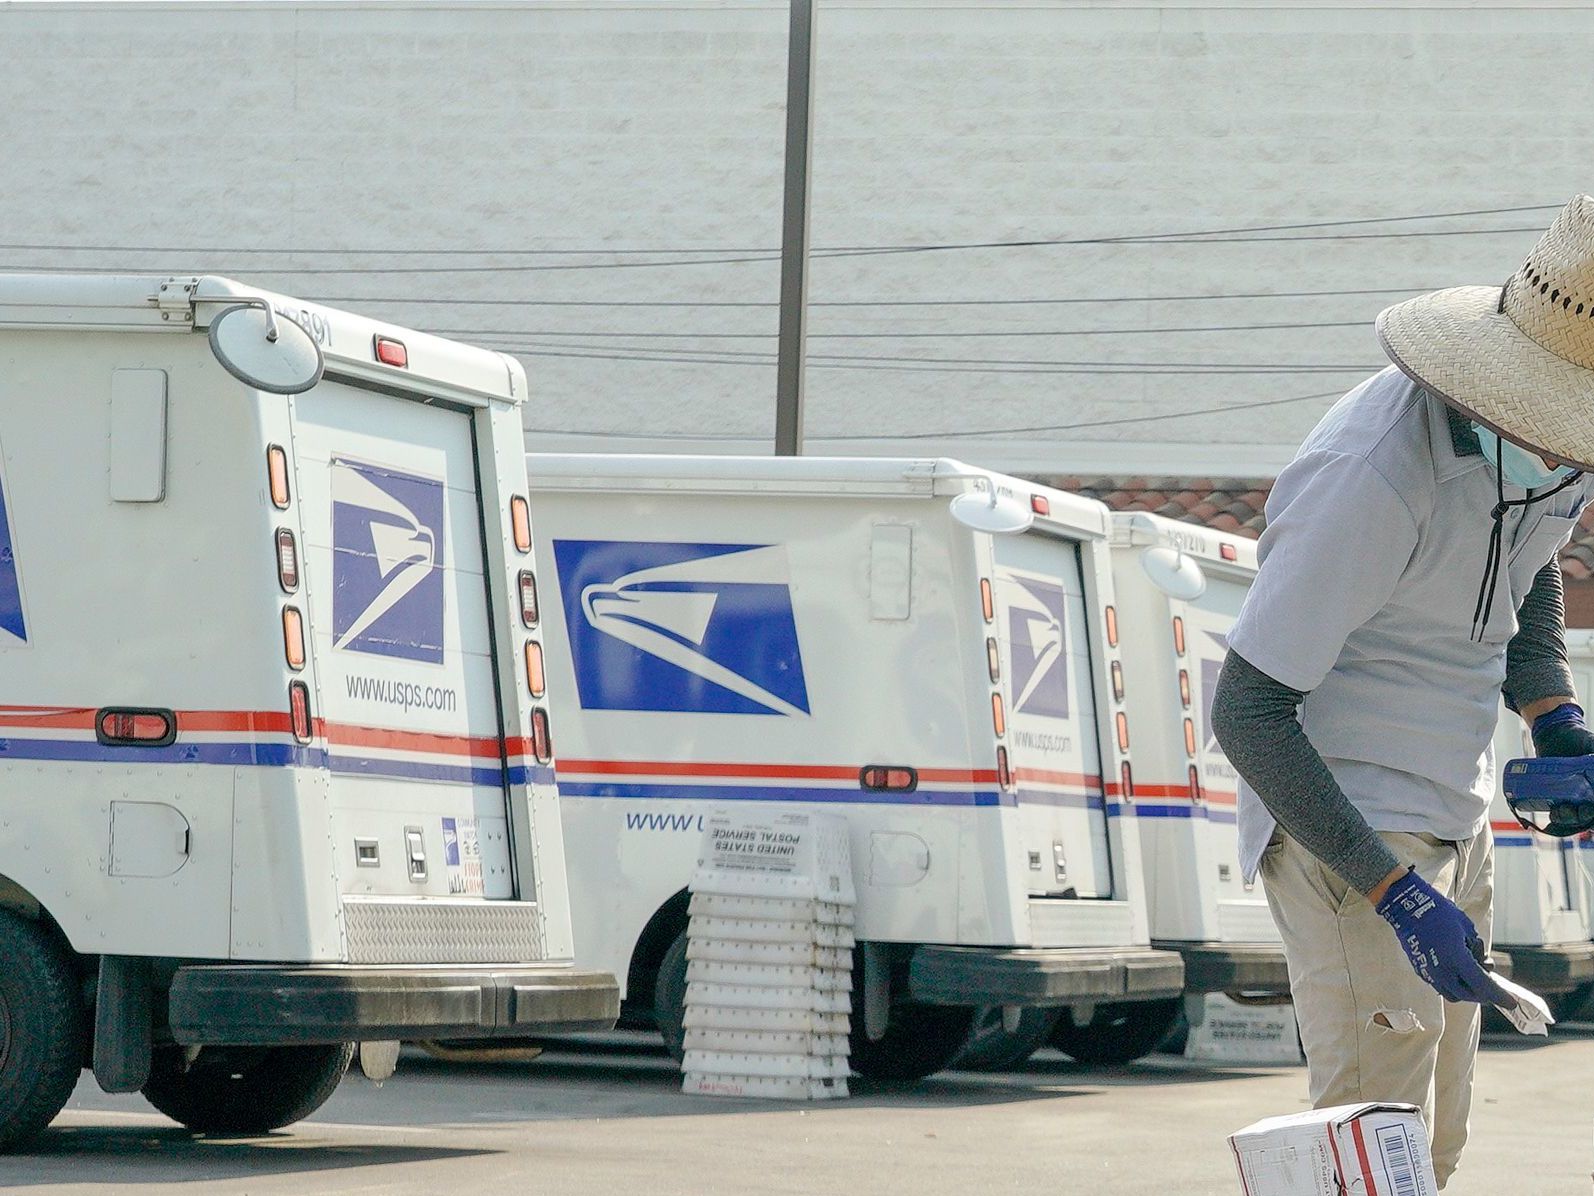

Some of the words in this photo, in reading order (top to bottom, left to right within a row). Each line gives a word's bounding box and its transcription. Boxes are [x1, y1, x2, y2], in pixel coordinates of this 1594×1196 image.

[346, 674, 456, 713] www.usps.com
[711, 827, 755, 842] SERVICE
[759, 831, 800, 845] POSTAL
[713, 840, 754, 853] STATES
[756, 844, 795, 856] UNITED
